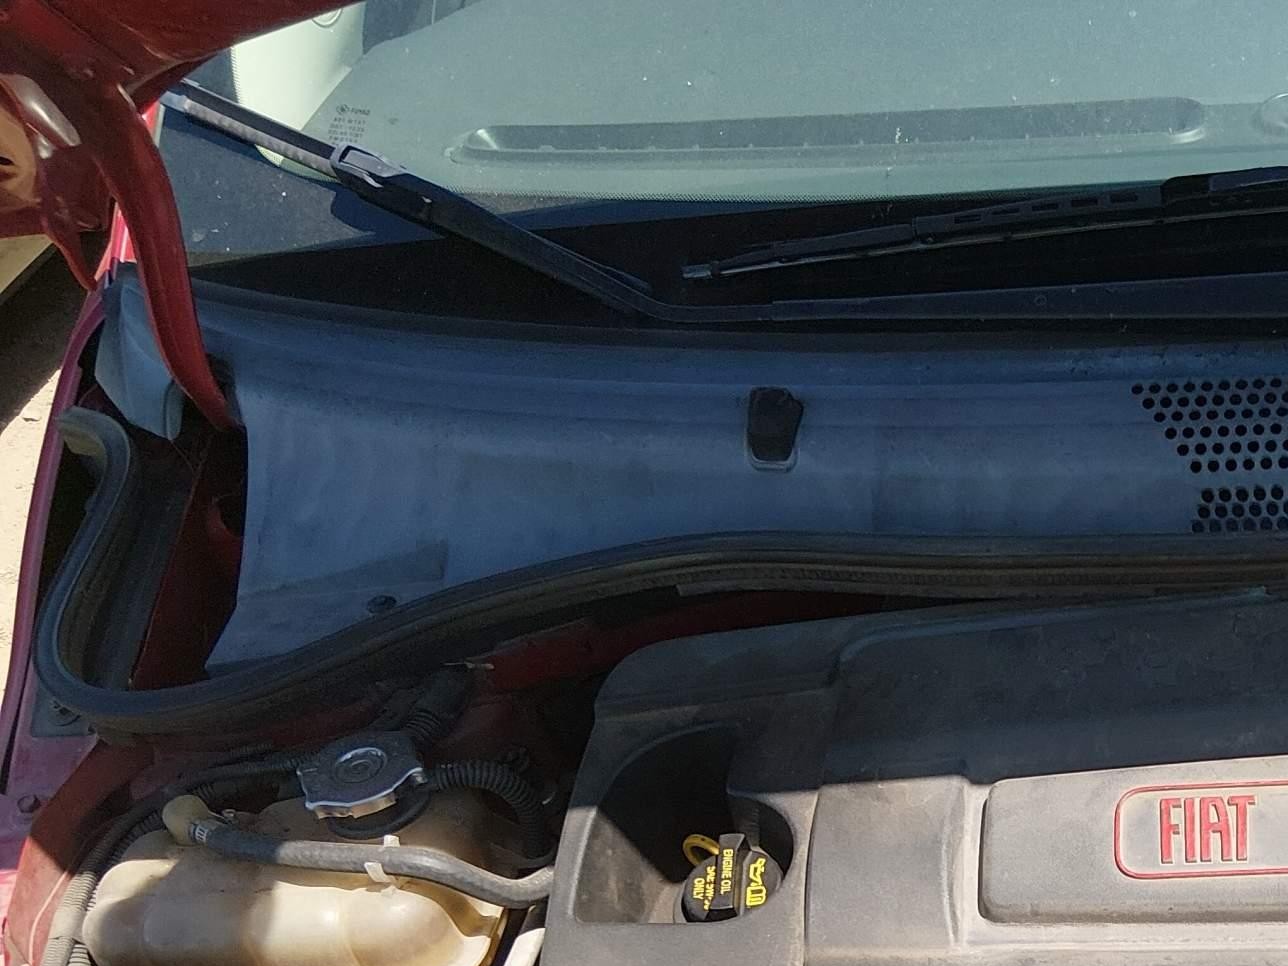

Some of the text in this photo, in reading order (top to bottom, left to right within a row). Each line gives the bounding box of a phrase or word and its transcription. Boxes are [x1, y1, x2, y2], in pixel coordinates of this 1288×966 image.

[1159, 795, 1256, 864] FIAT
[693, 878, 705, 899] ONLY
[720, 848, 733, 895] ENGINE OIL
